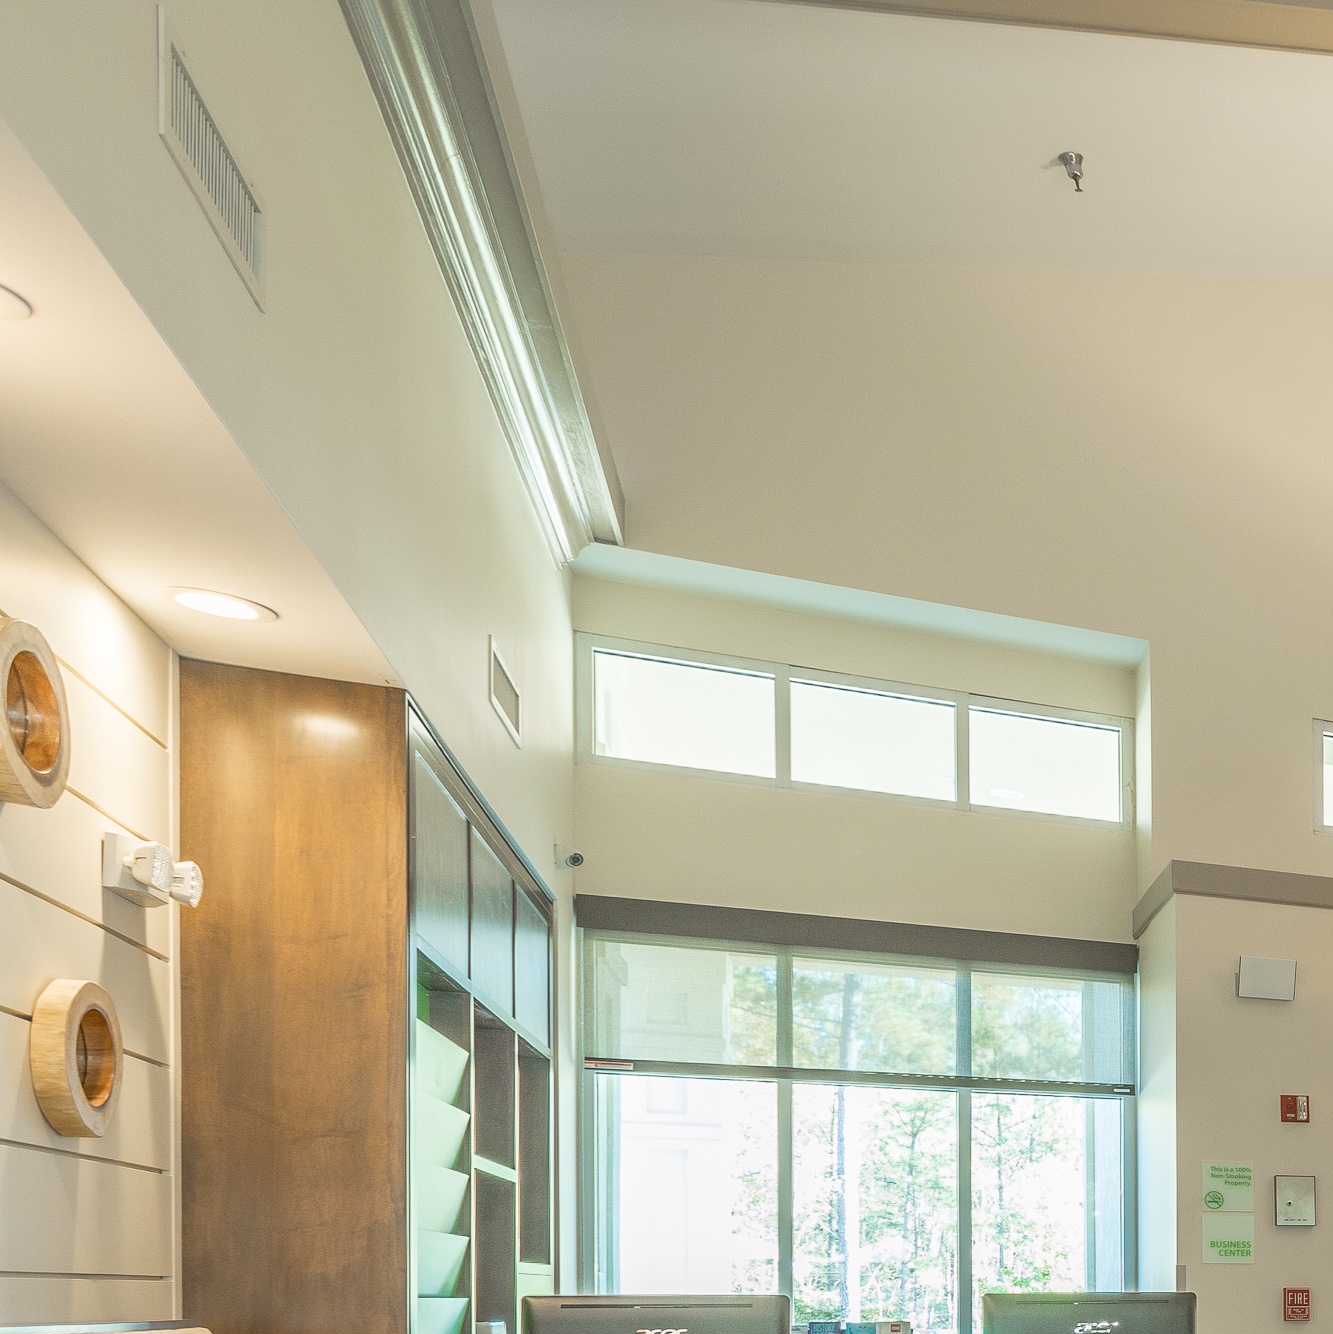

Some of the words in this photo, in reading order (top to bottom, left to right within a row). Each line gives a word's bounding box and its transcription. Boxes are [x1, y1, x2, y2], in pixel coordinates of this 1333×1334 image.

[1210, 1172, 1252, 1181] Non-Smoking
[1210, 1240, 1251, 1249] BUSINESS
[1218, 1249, 1251, 1257] CENTER
[1288, 1292, 1309, 1305] FIRE
[1073, 1321, 1119, 1334] acer
